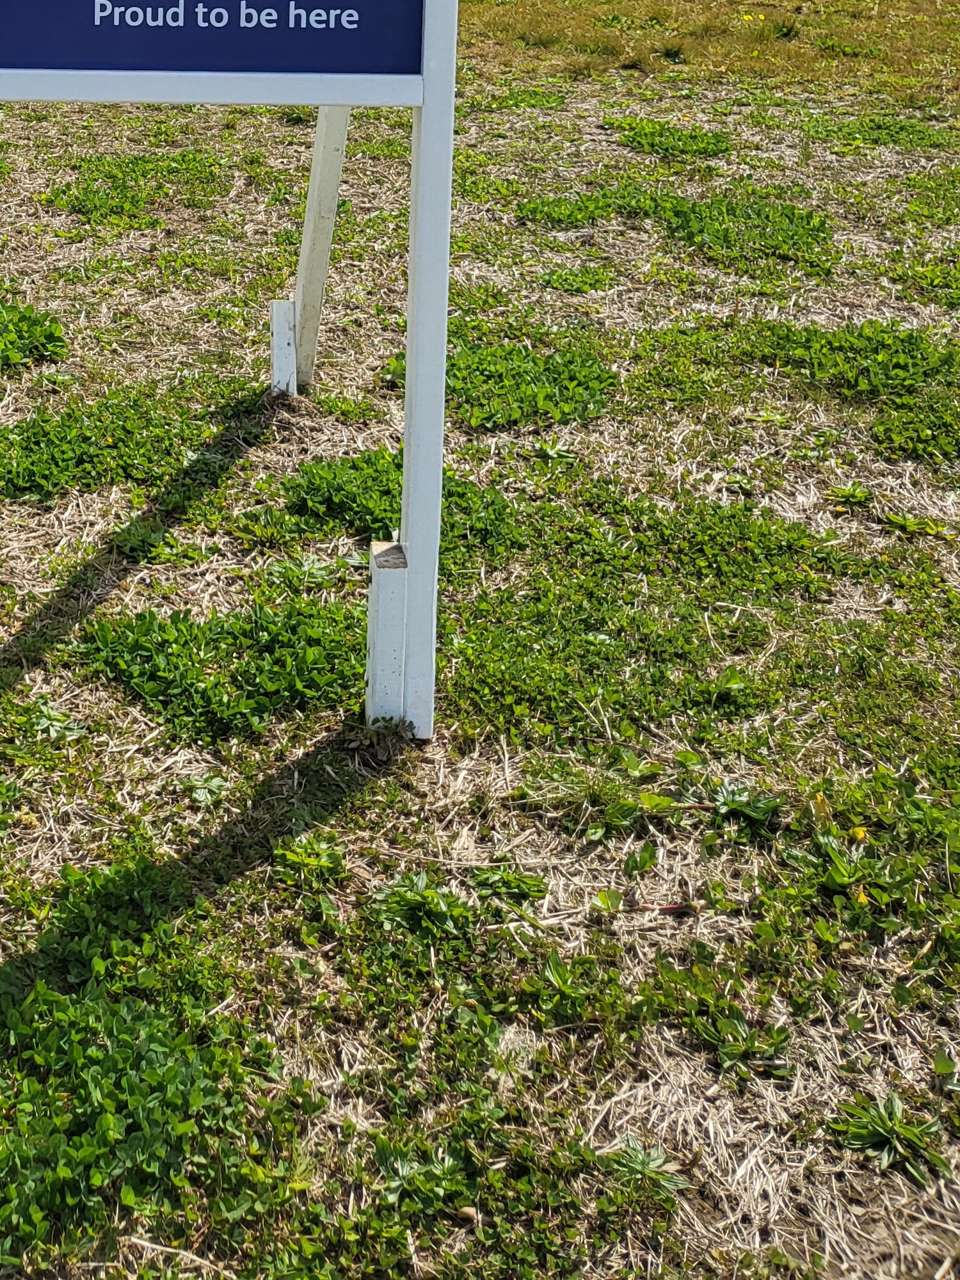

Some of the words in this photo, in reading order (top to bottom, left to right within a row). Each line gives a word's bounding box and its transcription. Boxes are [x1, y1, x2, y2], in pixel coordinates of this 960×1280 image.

[94, 0, 185, 28] Proud
[195, 3, 229, 28] to
[239, 0, 278, 28] be
[288, 0, 359, 29] here
